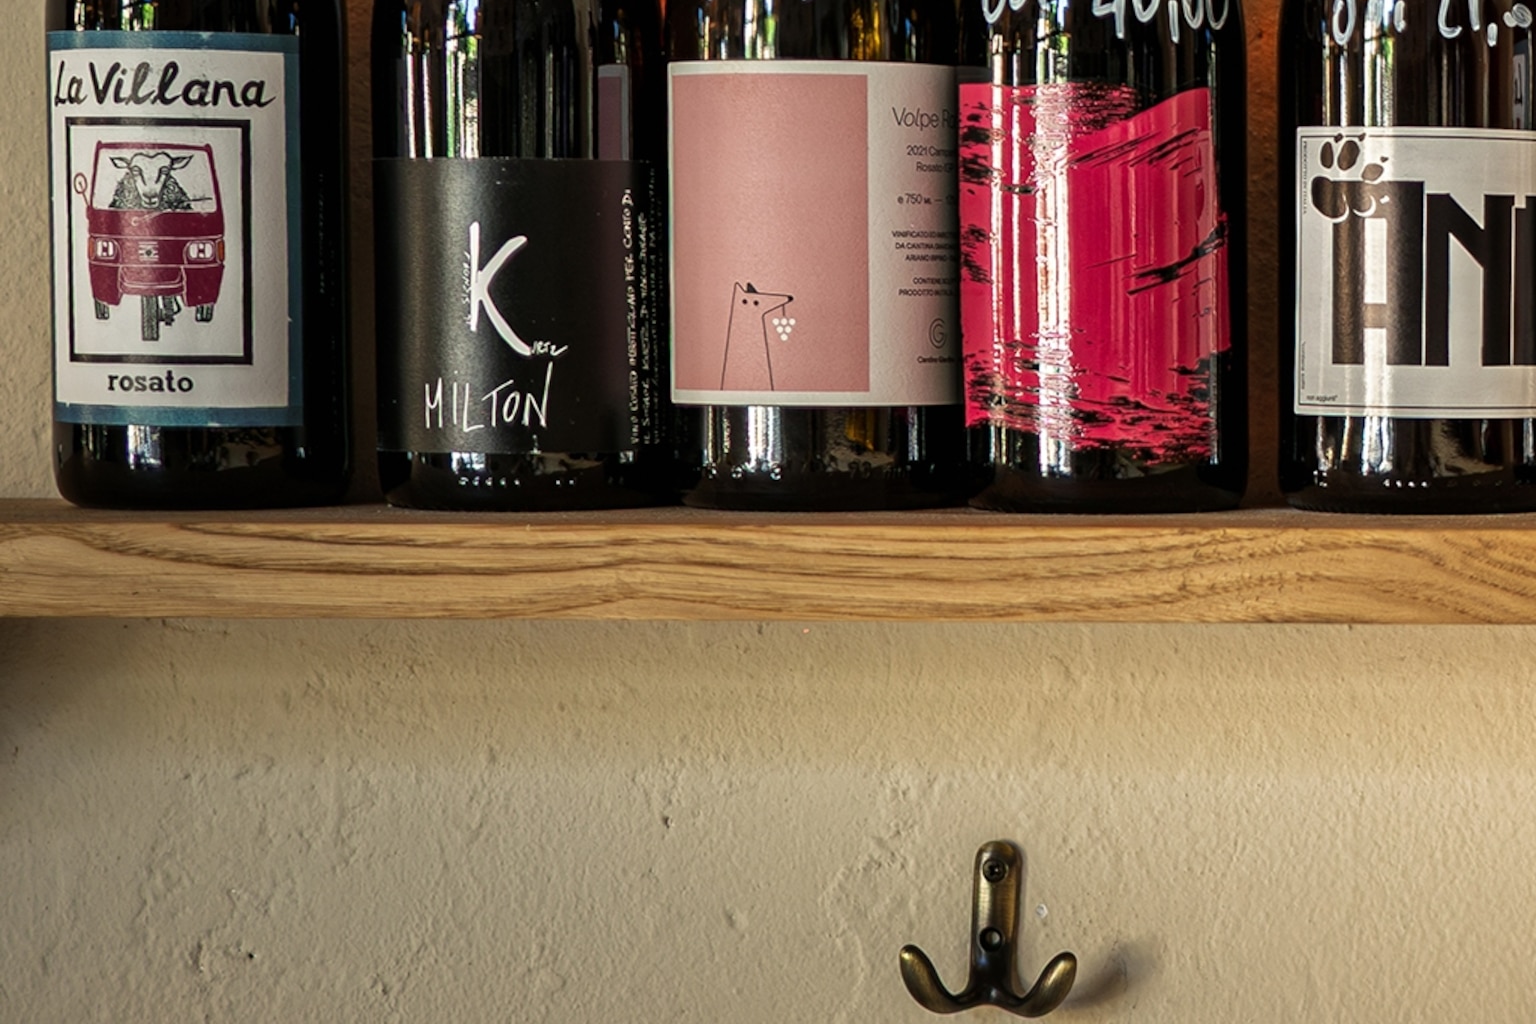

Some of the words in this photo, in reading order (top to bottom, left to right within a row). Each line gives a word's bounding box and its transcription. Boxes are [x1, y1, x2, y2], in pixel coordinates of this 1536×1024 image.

[55, 60, 87, 107] La
[88, 60, 277, 108] Villana
[892, 106, 940, 131] Volpe
[906, 145, 928, 157] 2021
[916, 161, 944, 173] Rosato
[905, 193, 922, 205] 750
[895, 242, 905, 250] DA
[107, 370, 194, 393] rosato
[425, 361, 553, 433] MILTON
[631, 416, 640, 444] VINO
